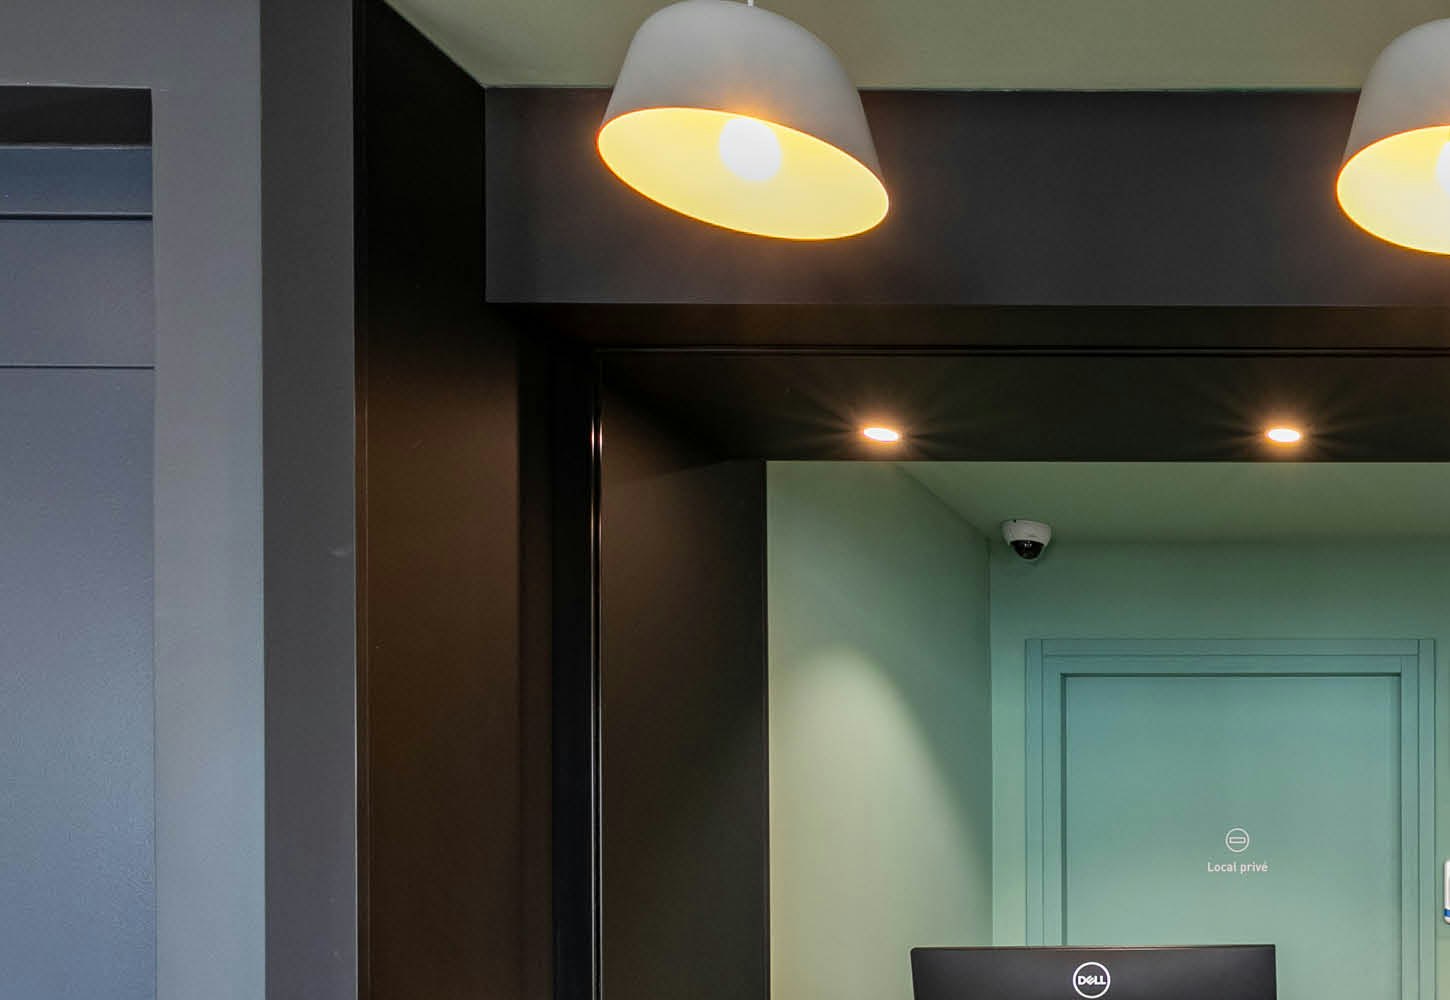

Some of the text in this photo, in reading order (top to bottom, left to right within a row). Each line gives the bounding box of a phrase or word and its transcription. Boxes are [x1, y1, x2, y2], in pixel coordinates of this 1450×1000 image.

[1207, 861, 1268, 875] Local privé
[1077, 975, 1107, 985] DELL
